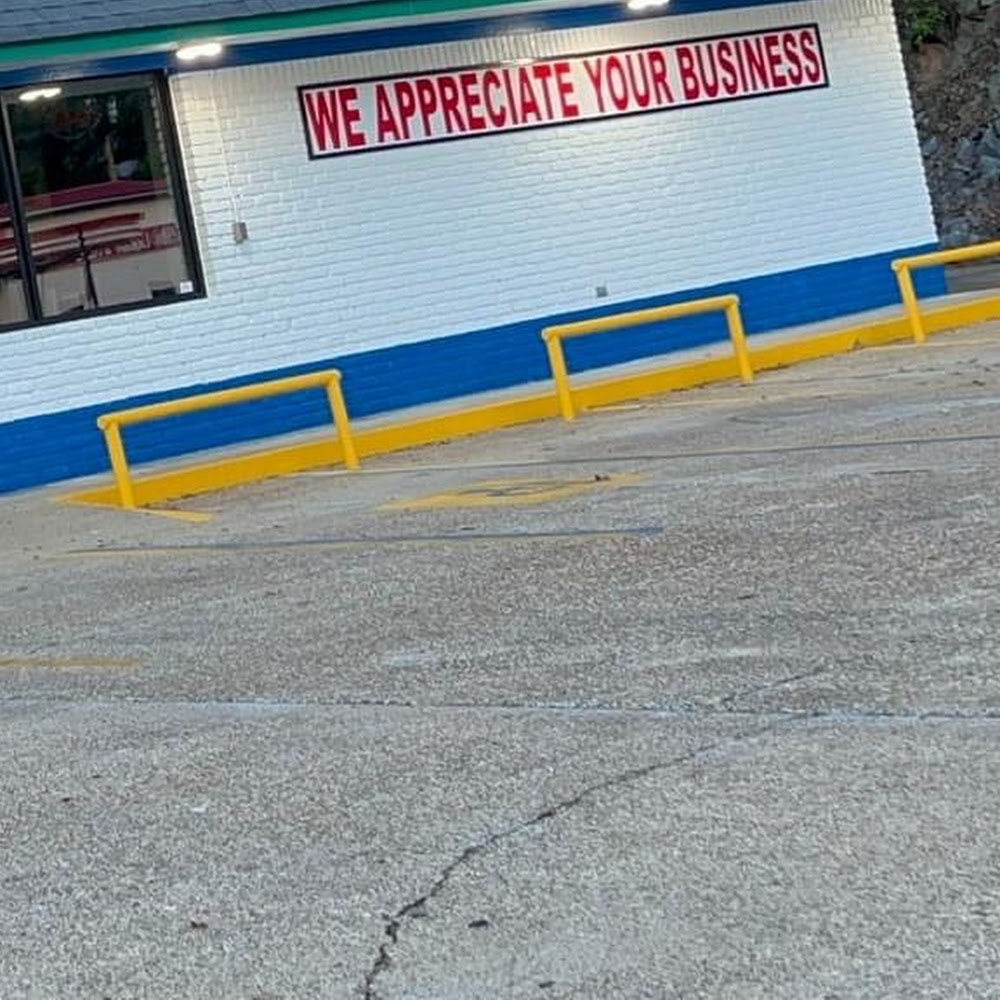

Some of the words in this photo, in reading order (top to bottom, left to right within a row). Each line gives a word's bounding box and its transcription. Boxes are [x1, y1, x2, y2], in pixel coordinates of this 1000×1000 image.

[306, 87, 365, 151] WE
[376, 60, 579, 142] APPRECIATE
[585, 47, 675, 113] YOUR
[681, 30, 821, 101] BUSINESS
